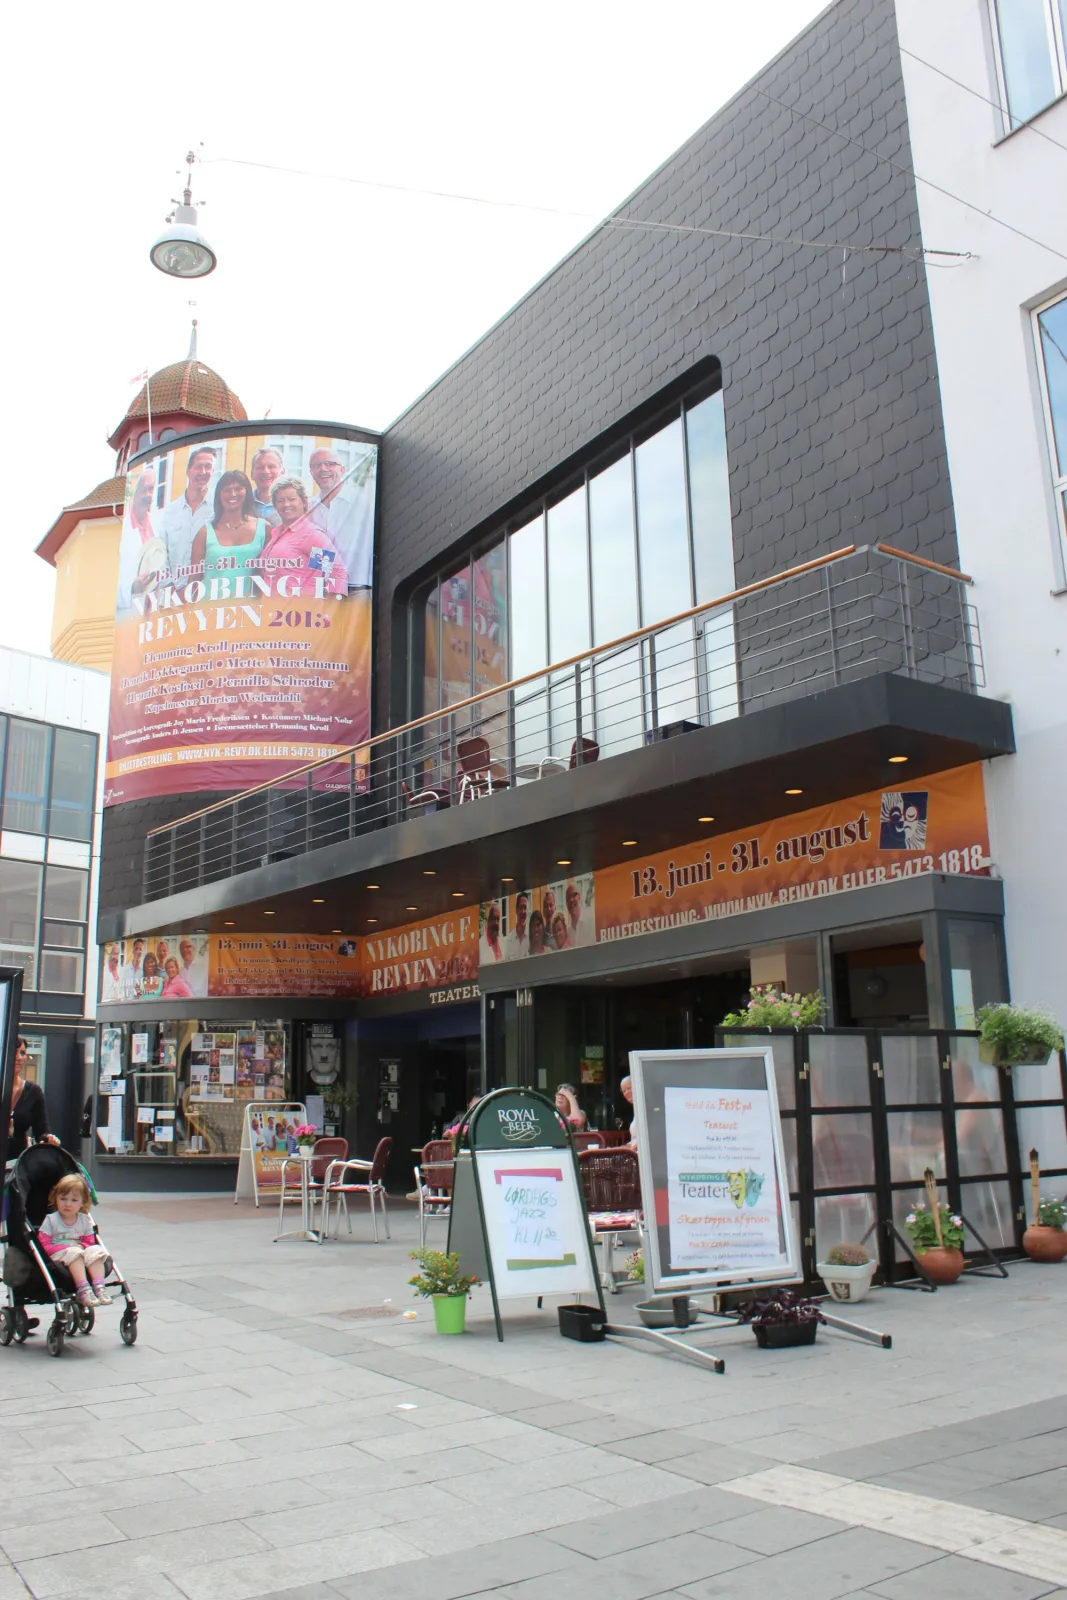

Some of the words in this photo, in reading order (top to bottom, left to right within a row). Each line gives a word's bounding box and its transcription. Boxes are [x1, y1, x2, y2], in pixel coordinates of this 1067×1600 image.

[155, 567, 173, 582] 13.
[174, 559, 205, 581] juni
[216, 556, 241, 571] 31.
[245, 555, 304, 572] august
[132, 575, 303, 617] NYKØBING
[312, 576, 343, 601] F.
[138, 604, 264, 645] REVYEN
[268, 610, 331, 629] 2013
[143, 647, 193, 665] Flemming
[196, 640, 229, 654] Kroll
[230, 640, 312, 653] præsenterer
[150, 660, 214, 682] Lykkegaard
[226, 656, 265, 669] Mette
[267, 656, 350, 672] Marckmann
[126, 686, 158, 705] Henrik
[216, 675, 269, 689] Pernille
[199, 694, 238, 706] Morten
[309, 724, 329, 732] Kroll
[263, 746, 289, 757] ELLER
[291, 747, 315, 757] 5473
[631, 866, 663, 899] 13.
[665, 851, 713, 898] juni
[730, 837, 771, 874] 31.
[775, 810, 872, 864] august
[842, 866, 887, 889] ELLER
[889, 855, 935, 878] 5473
[938, 844, 983, 874] 1818
[459, 916, 475, 942] F.
[217, 939, 235, 951] 13.
[237, 939, 262, 952] juni
[272, 939, 291, 951] 31.
[294, 941, 334, 952] august
[371, 955, 437, 991] REVYEN
[429, 984, 482, 1005] TEATER
[717, 1097, 742, 1111] Fest
[497, 1108, 540, 1122] ROYAL
[508, 1121, 535, 1131] BEER
[504, 1186, 558, 1207] LØRDAGS
[678, 1183, 729, 1199] Teater
[510, 1207, 547, 1224] JAZZ
